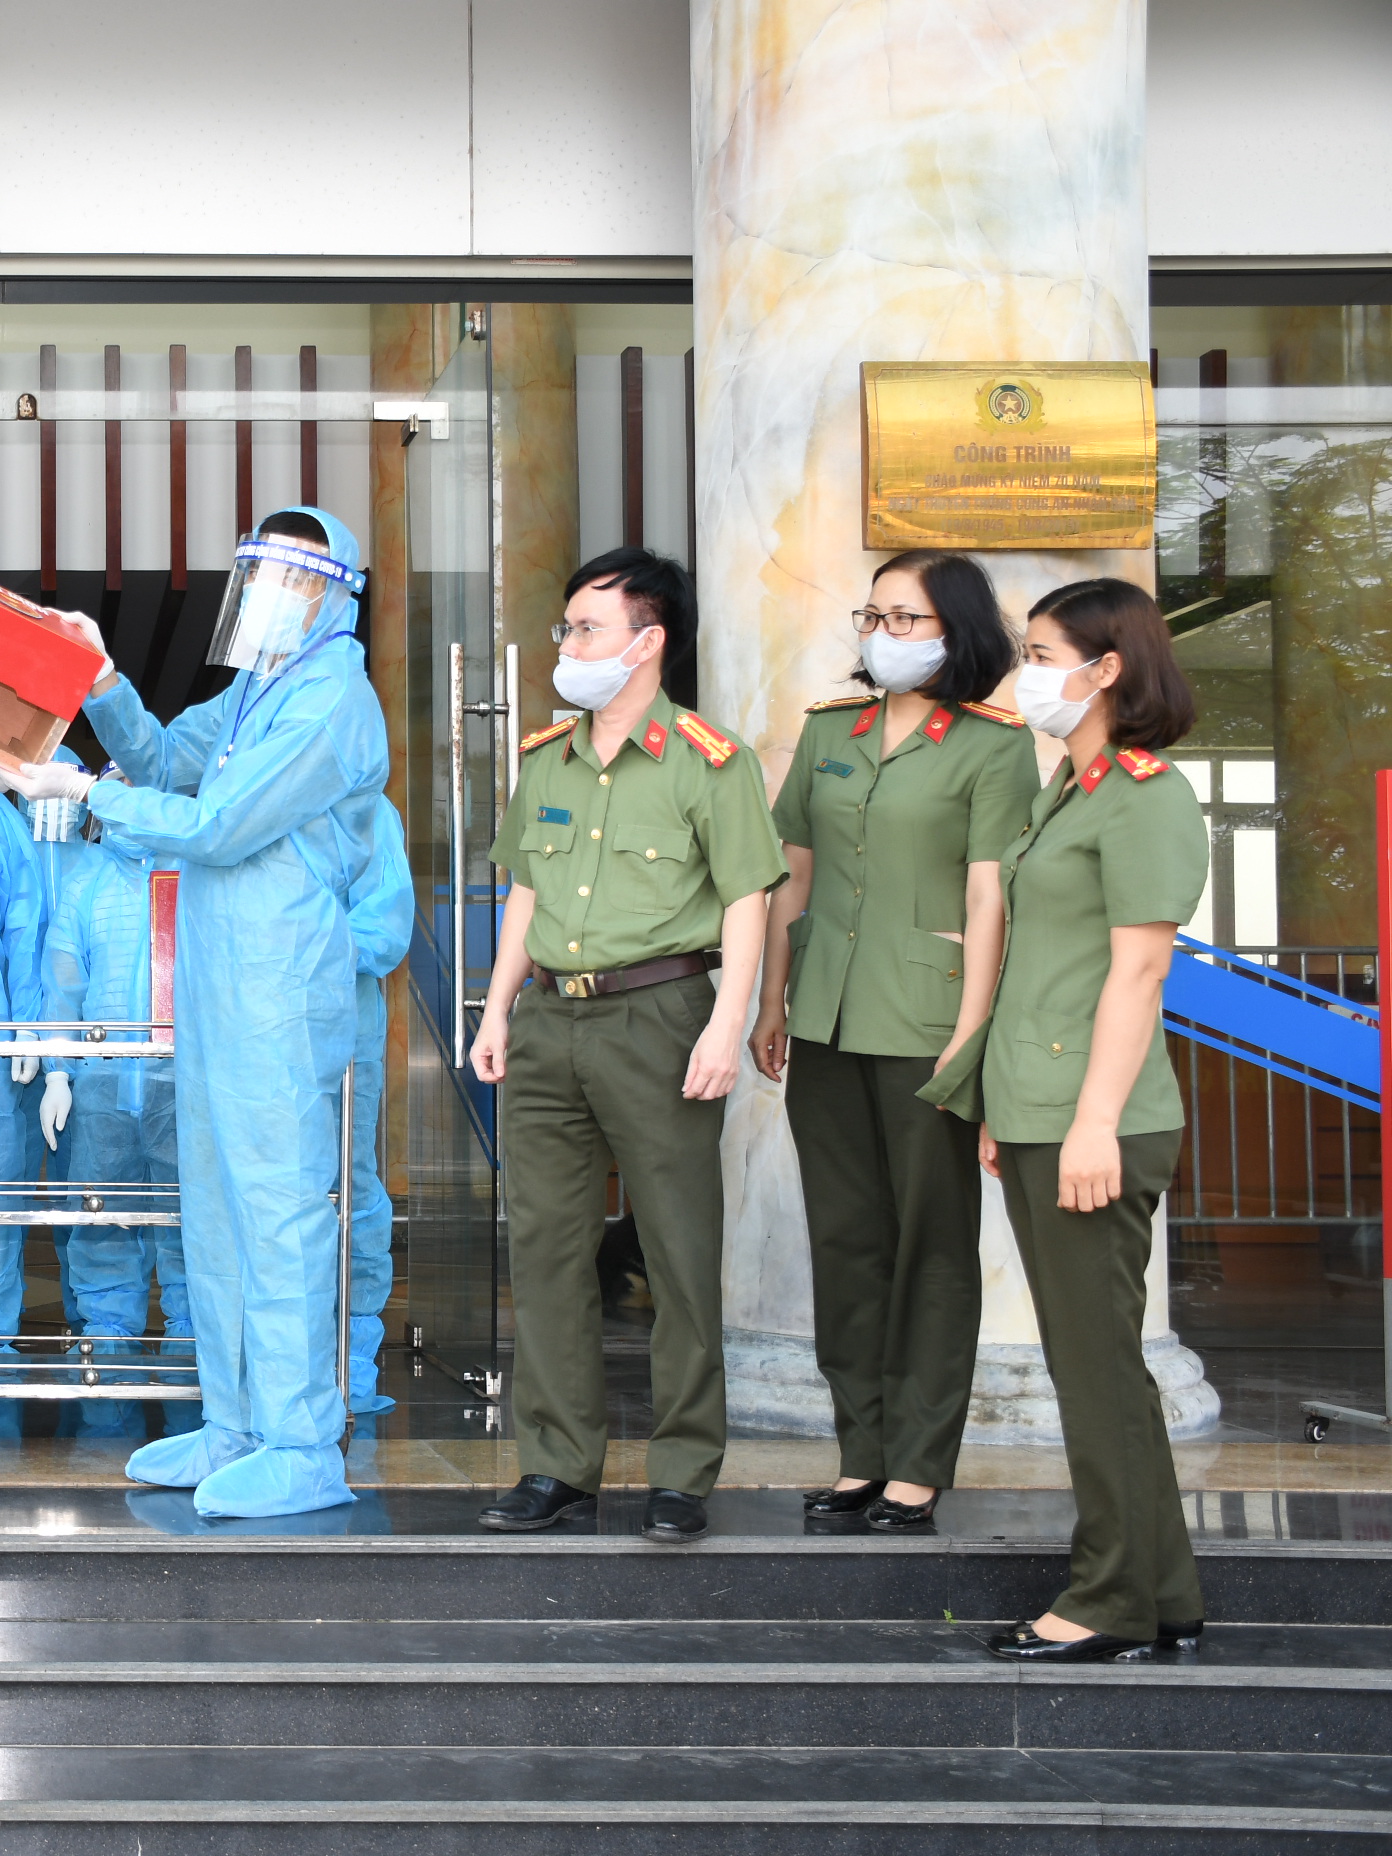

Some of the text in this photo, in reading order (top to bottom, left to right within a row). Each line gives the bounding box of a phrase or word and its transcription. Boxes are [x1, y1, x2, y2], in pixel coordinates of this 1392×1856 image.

[953, 442, 1071, 463] CÔNG TRÌNH
[925, 472, 957, 488] CHÀO
[961, 473, 996, 488] MỪNG
[1018, 474, 1050, 491] NIỆM
[319, 560, 343, 579] COVID-19
